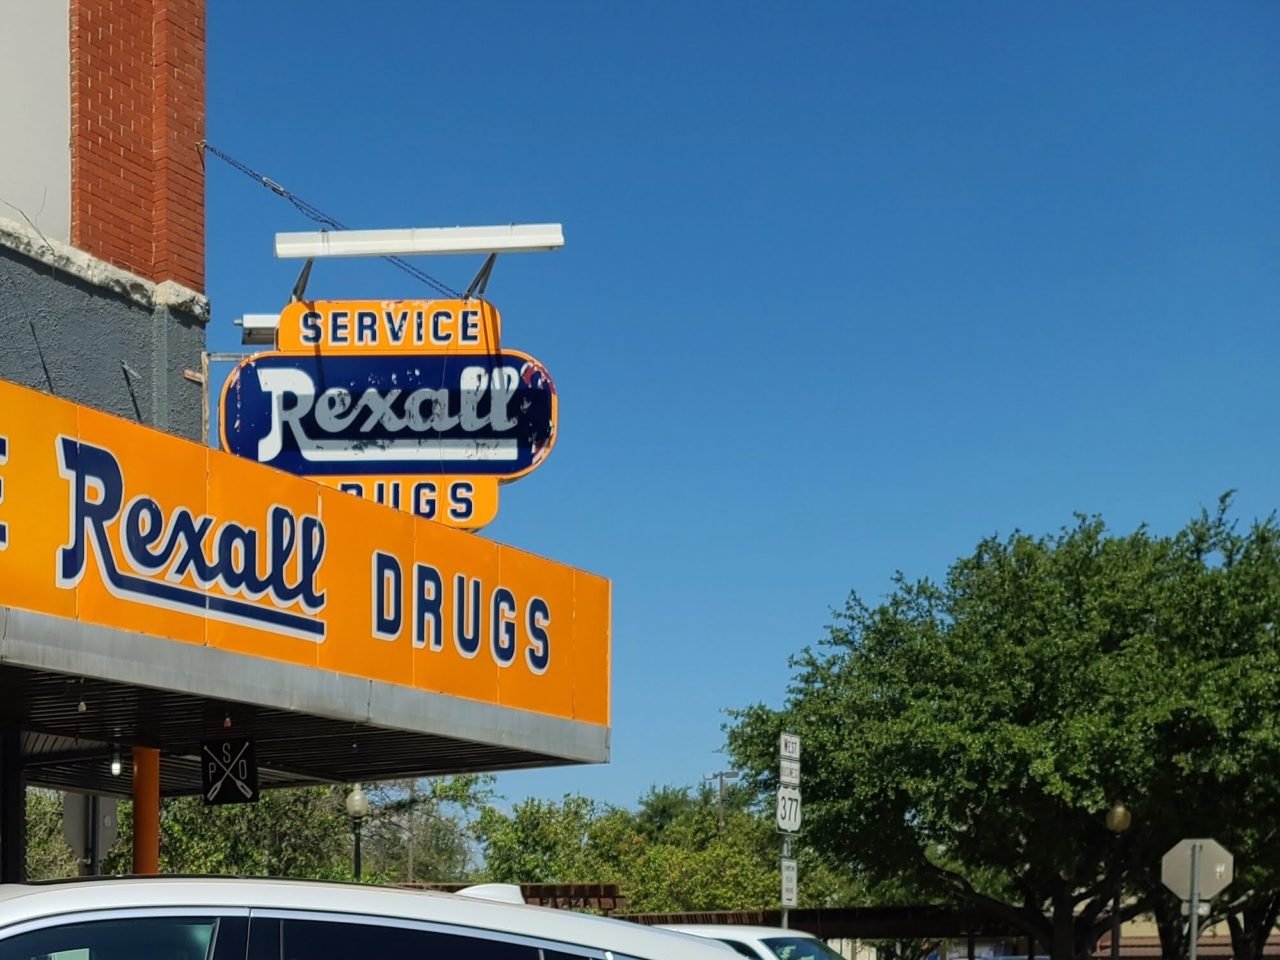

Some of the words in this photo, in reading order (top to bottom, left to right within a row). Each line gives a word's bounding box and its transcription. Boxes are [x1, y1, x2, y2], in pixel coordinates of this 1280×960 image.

[299, 309, 481, 345] SERVICE
[257, 366, 519, 462] Rexall
[337, 482, 475, 520] UGS
[55, 435, 326, 643] Rexall
[372, 551, 551, 677] DRUGS
[780, 796, 799, 822] 377
